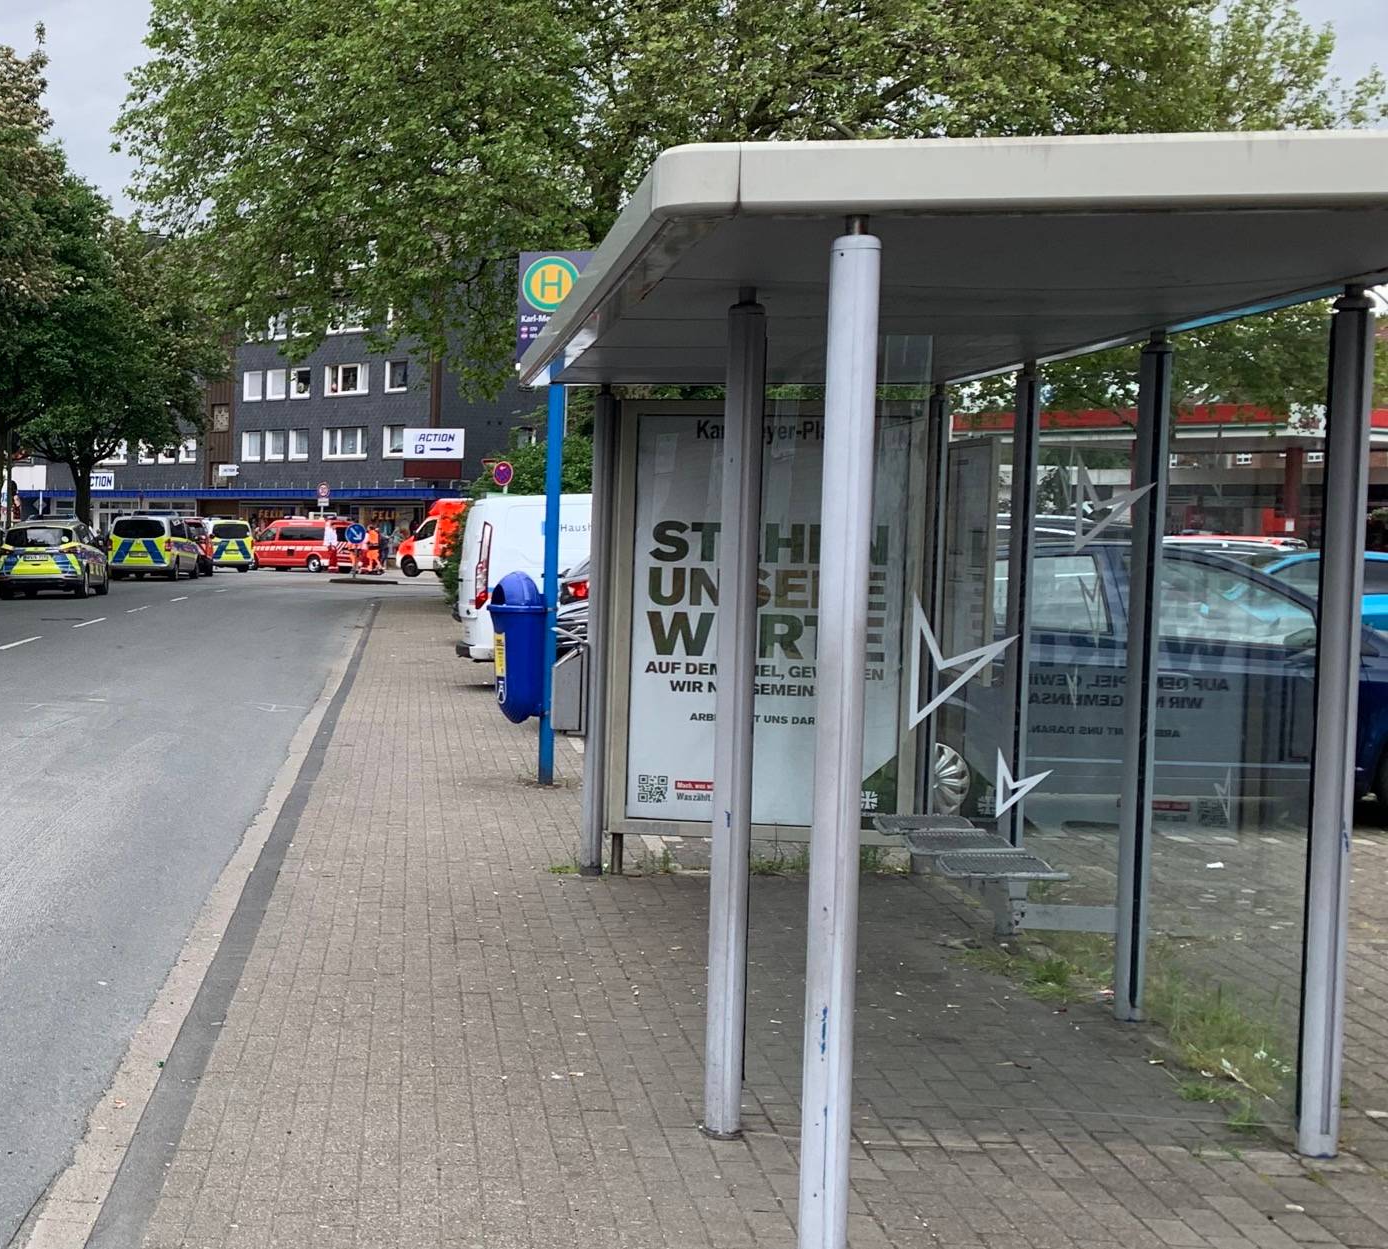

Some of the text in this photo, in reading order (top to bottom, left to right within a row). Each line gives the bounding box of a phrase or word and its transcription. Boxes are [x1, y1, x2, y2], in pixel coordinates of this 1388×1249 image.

[541, 269, 563, 299] H
[418, 433, 456, 442] ACTION
[90, 475, 112, 488] CTION
[644, 661, 681, 674] AUF
[670, 679, 704, 693] WIR
[764, 715, 789, 725] UNS
[791, 716, 816, 726] DAR
